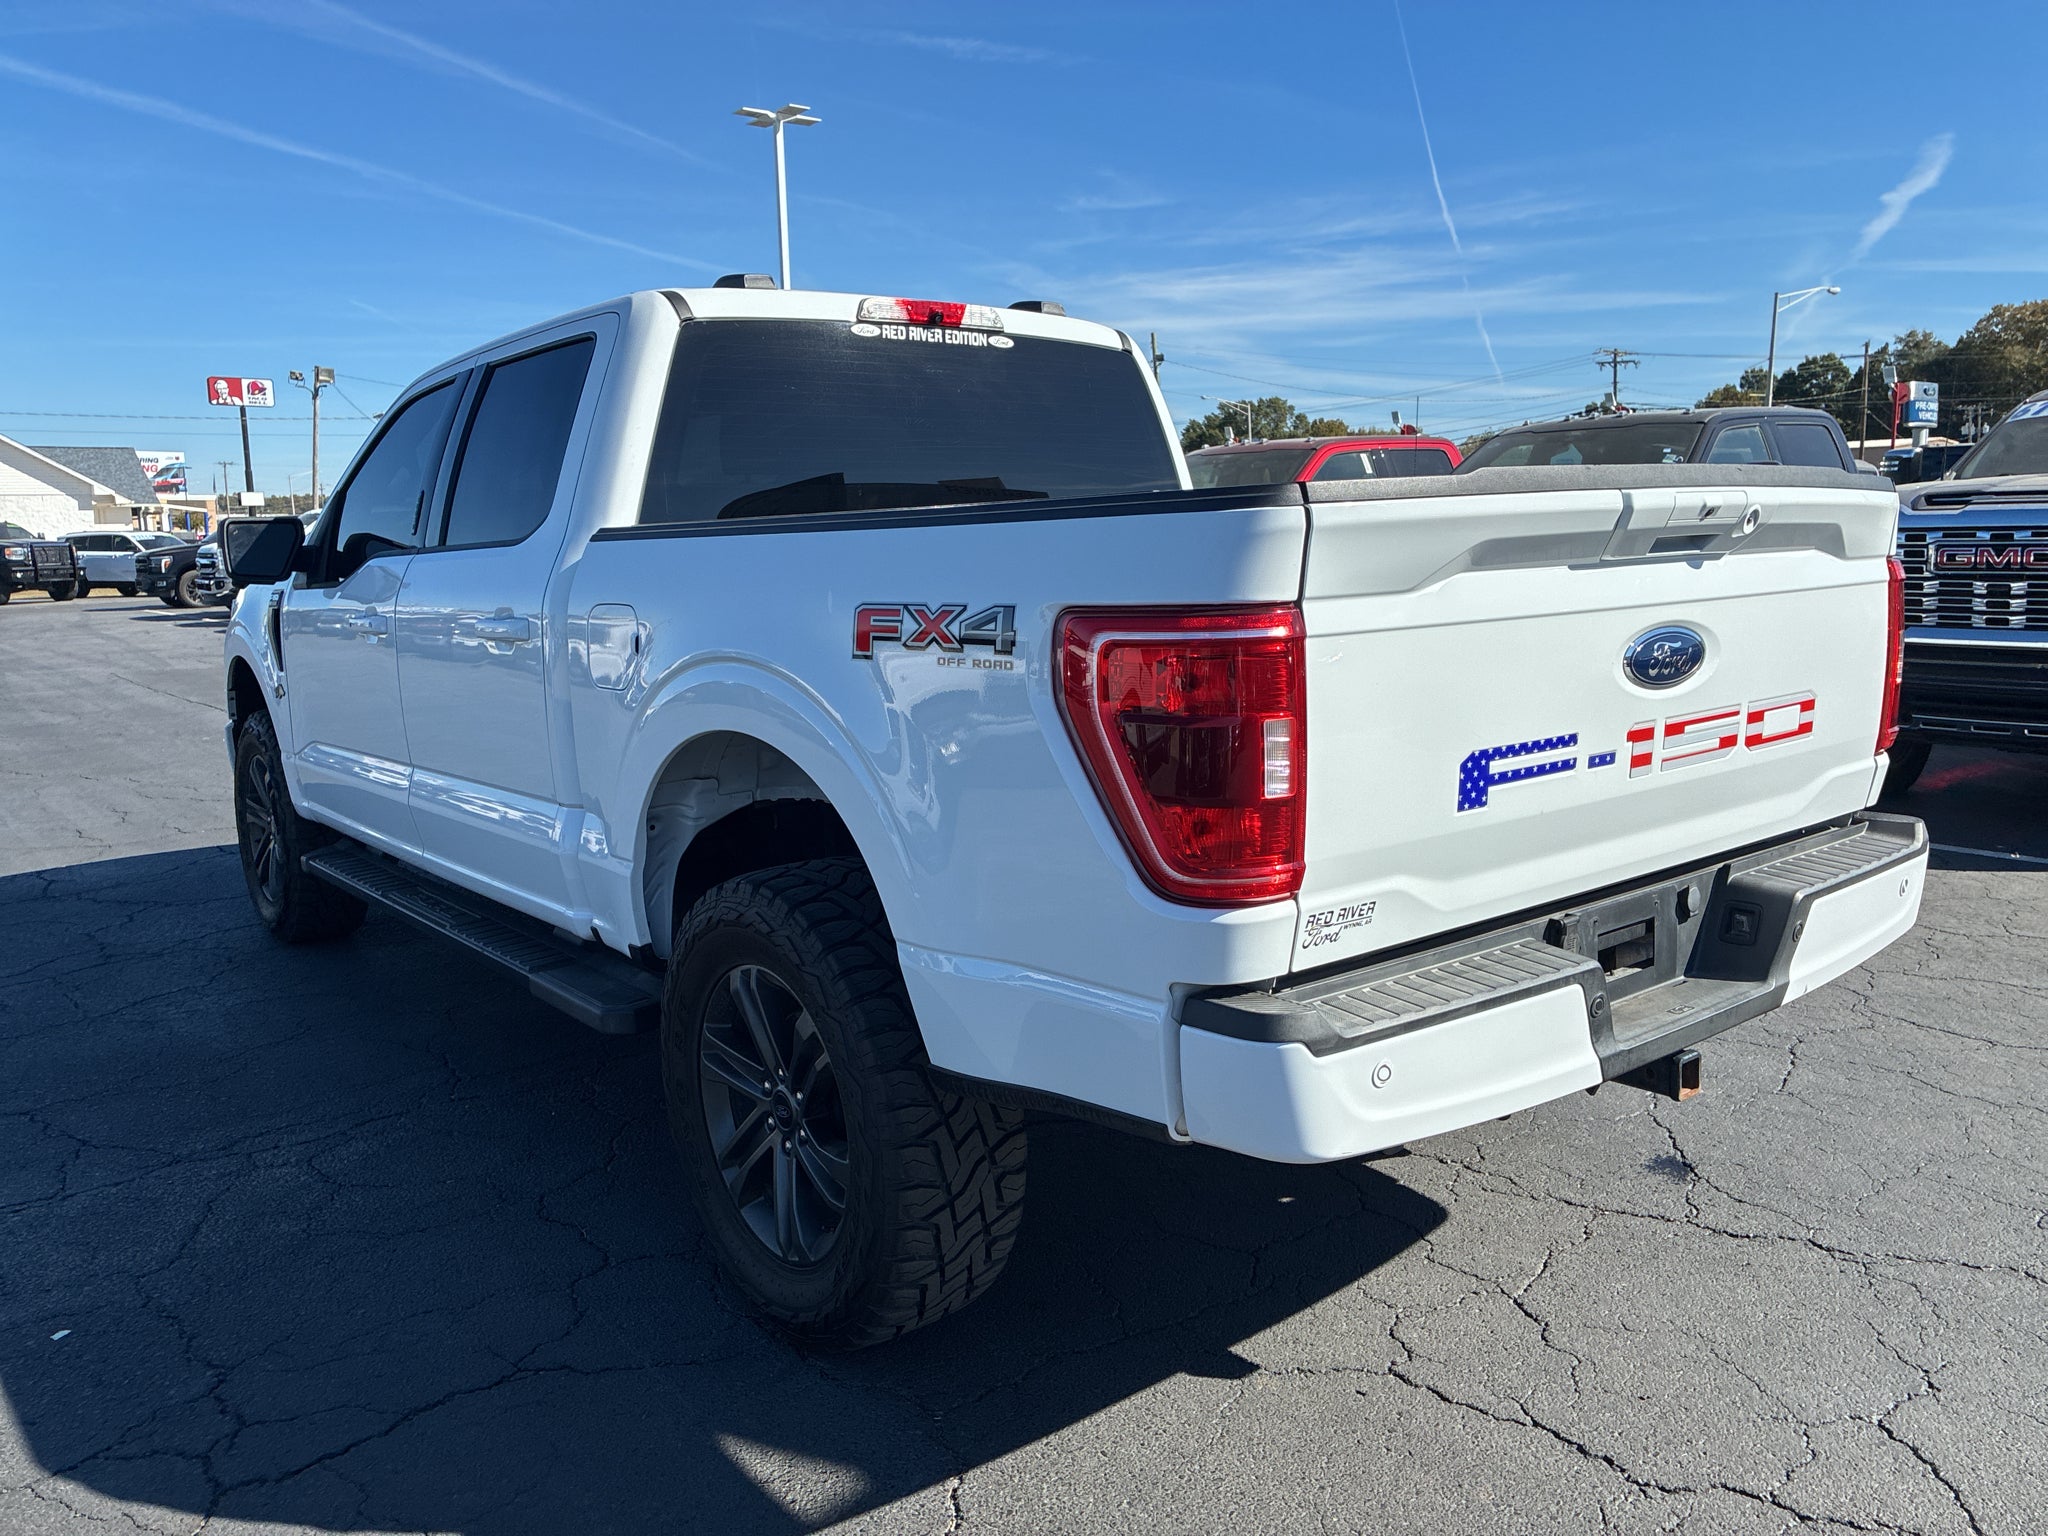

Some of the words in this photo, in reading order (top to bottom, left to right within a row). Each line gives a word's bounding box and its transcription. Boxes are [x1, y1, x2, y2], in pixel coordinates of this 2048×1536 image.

[882, 324, 906, 340] RED
[909, 326, 943, 343] RIVER
[945, 329, 988, 347] EDITION
[1937, 547, 2048, 568] GMC
[852, 603, 1017, 660] FX4
[937, 656, 967, 668] OFF
[972, 658, 1014, 671] ROAD
[1646, 641, 1692, 677] Ford
[1456, 690, 1817, 815] F-150
[1305, 910, 1334, 929] RED
[1336, 901, 1377, 922] RIVER
[1302, 926, 1343, 949] Ford
